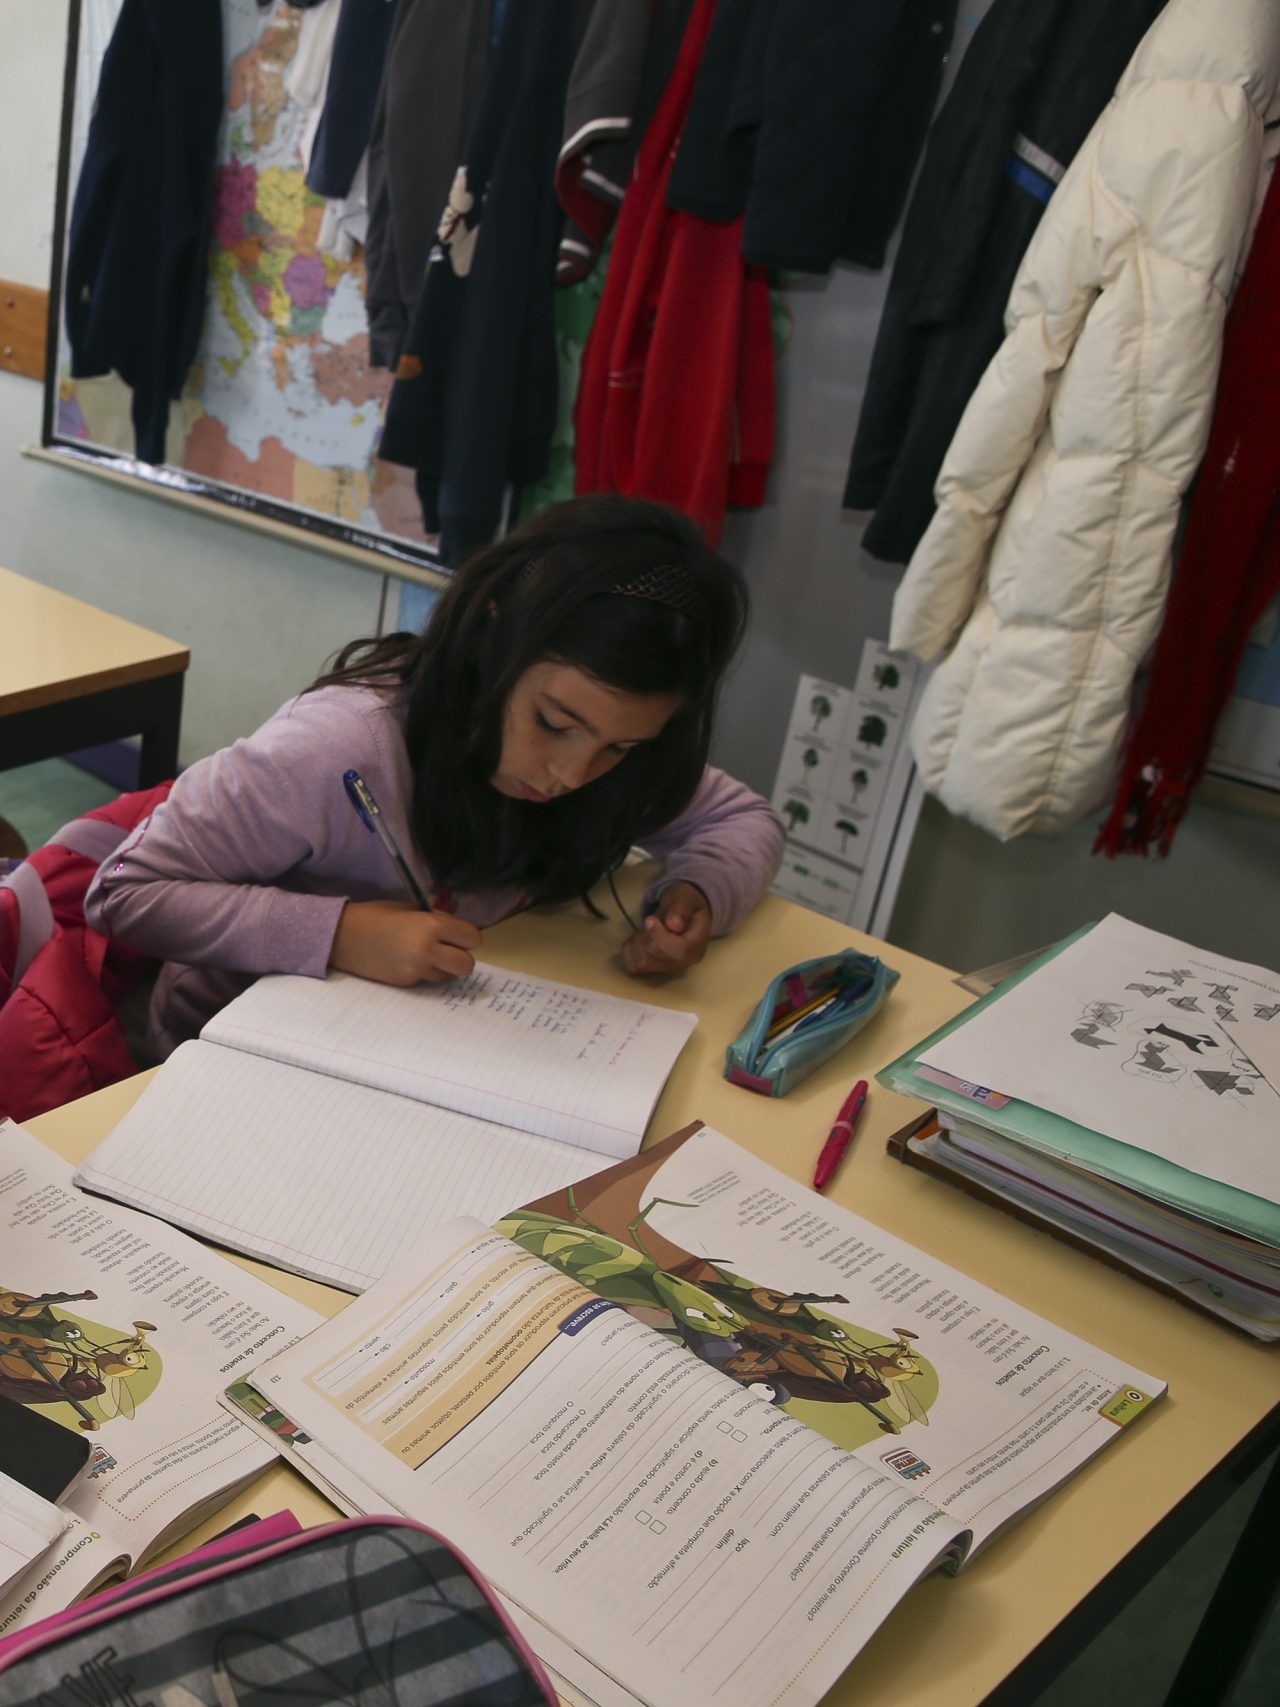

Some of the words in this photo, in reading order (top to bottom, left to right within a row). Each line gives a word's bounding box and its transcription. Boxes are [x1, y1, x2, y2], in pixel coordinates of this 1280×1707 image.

[443, 1281, 458, 1293] gato
[225, 1306, 236, 1314] seu
[233, 1309, 247, 1319] toca
[479, 1300, 495, 1313] grilo
[529, 1300, 555, 1321] Natureza
[547, 1297, 573, 1318] procuram
[249, 1310, 260, 1320] que
[259, 1316, 269, 1324] Ao
[563, 1307, 594, 1331] escreve...
[247, 1322, 261, 1332] belo
[520, 1319, 533, 1330] são
[522, 1316, 550, 1342] reproduzir
[239, 1330, 250, 1339] Sol
[251, 1324, 285, 1349] Concerto
[363, 1335, 380, 1349] vento
[243, 1346, 254, 1356] de
[378, 1342, 391, 1353] cão
[515, 1340, 524, 1348] os
[503, 1347, 518, 1360] sons
[1020, 1344, 1050, 1365] Concerto
[218, 1353, 246, 1373] insetos
[408, 1357, 435, 1380] mosquito
[481, 1360, 506, 1382] emitidos
[641, 1358, 655, 1370] com
[1013, 1363, 1025, 1372] de
[622, 1372, 640, 1387] nome
[994, 1369, 1019, 1386] insetos
[471, 1380, 484, 1392] por
[615, 1386, 626, 1396] do
[449, 1390, 474, 1411] pessoas,
[1095, 1388, 1112, 1401] Antes
[584, 1394, 620, 1427] instrumento
[631, 1393, 663, 1422] significado
[1108, 1398, 1132, 1416] Leitura
[427, 1410, 452, 1430] objetos,
[540, 1406, 569, 1432] mosquito
[696, 1408, 713, 1423] tenta
[551, 1414, 581, 1442] moscardo
[574, 1426, 588, 1438] que
[624, 1421, 635, 1431] da
[676, 1421, 699, 1444] explicar
[408, 1428, 431, 1447] animais
[528, 1431, 544, 1444] toca
[561, 1437, 578, 1452] cada
[605, 1429, 628, 1452] palavra
[400, 1446, 411, 1454] ou
[539, 1440, 555, 1454] toca
[693, 1449, 703, 1458] d)
[545, 1451, 565, 1469] inseto
[588, 1451, 608, 1471] «trilo»
[644, 1447, 676, 1479] significado
[707, 1458, 718, 1467] b)
[749, 1447, 776, 1473] seleciona
[827, 1460, 841, 1472] duas
[143, 1473, 152, 1481] da
[672, 1461, 692, 1482] cantor
[692, 1465, 711, 1483] ajuda
[737, 1471, 753, 1486] com
[563, 1475, 586, 1496] verifica
[637, 1478, 648, 1488] da
[733, 1484, 742, 1492] X
[807, 1469, 831, 1492] palavras
[115, 1478, 146, 1503] primavera
[556, 1494, 566, 1503] se
[796, 1490, 811, 1503] que
[610, 1486, 641, 1516] expressão
[664, 1487, 692, 1515] concerto.
[711, 1495, 732, 1516] opção
[839, 1484, 874, 1518] organizam-se
[601, 1514, 614, 1527] «Lá
[780, 1502, 801, 1523] rimam
[878, 1502, 907, 1530] constituem
[521, 1506, 554, 1536] significado
[701, 1514, 715, 1528] que
[830, 1516, 843, 1527] em
[585, 1524, 605, 1541] baila,
[911, 1524, 925, 1535] da
[509, 1534, 523, 1547] que
[578, 1539, 589, 1549] ao
[676, 1526, 706, 1556] completa
[714, 1528, 735, 1549] delfim
[733, 1536, 750, 1552] laço
[809, 1526, 835, 1552] quantas
[855, 1532, 878, 1556] poema
[890, 1533, 918, 1559] leitura
[568, 1547, 581, 1559] seu
[34, 1533, 92, 1593] Compreensão
[788, 1550, 815, 1581] estrofes?
[832, 1554, 861, 1584] Concerto
[825, 1583, 837, 1594] de
[23, 1590, 37, 1604] da
[805, 1592, 831, 1621] insetos?
